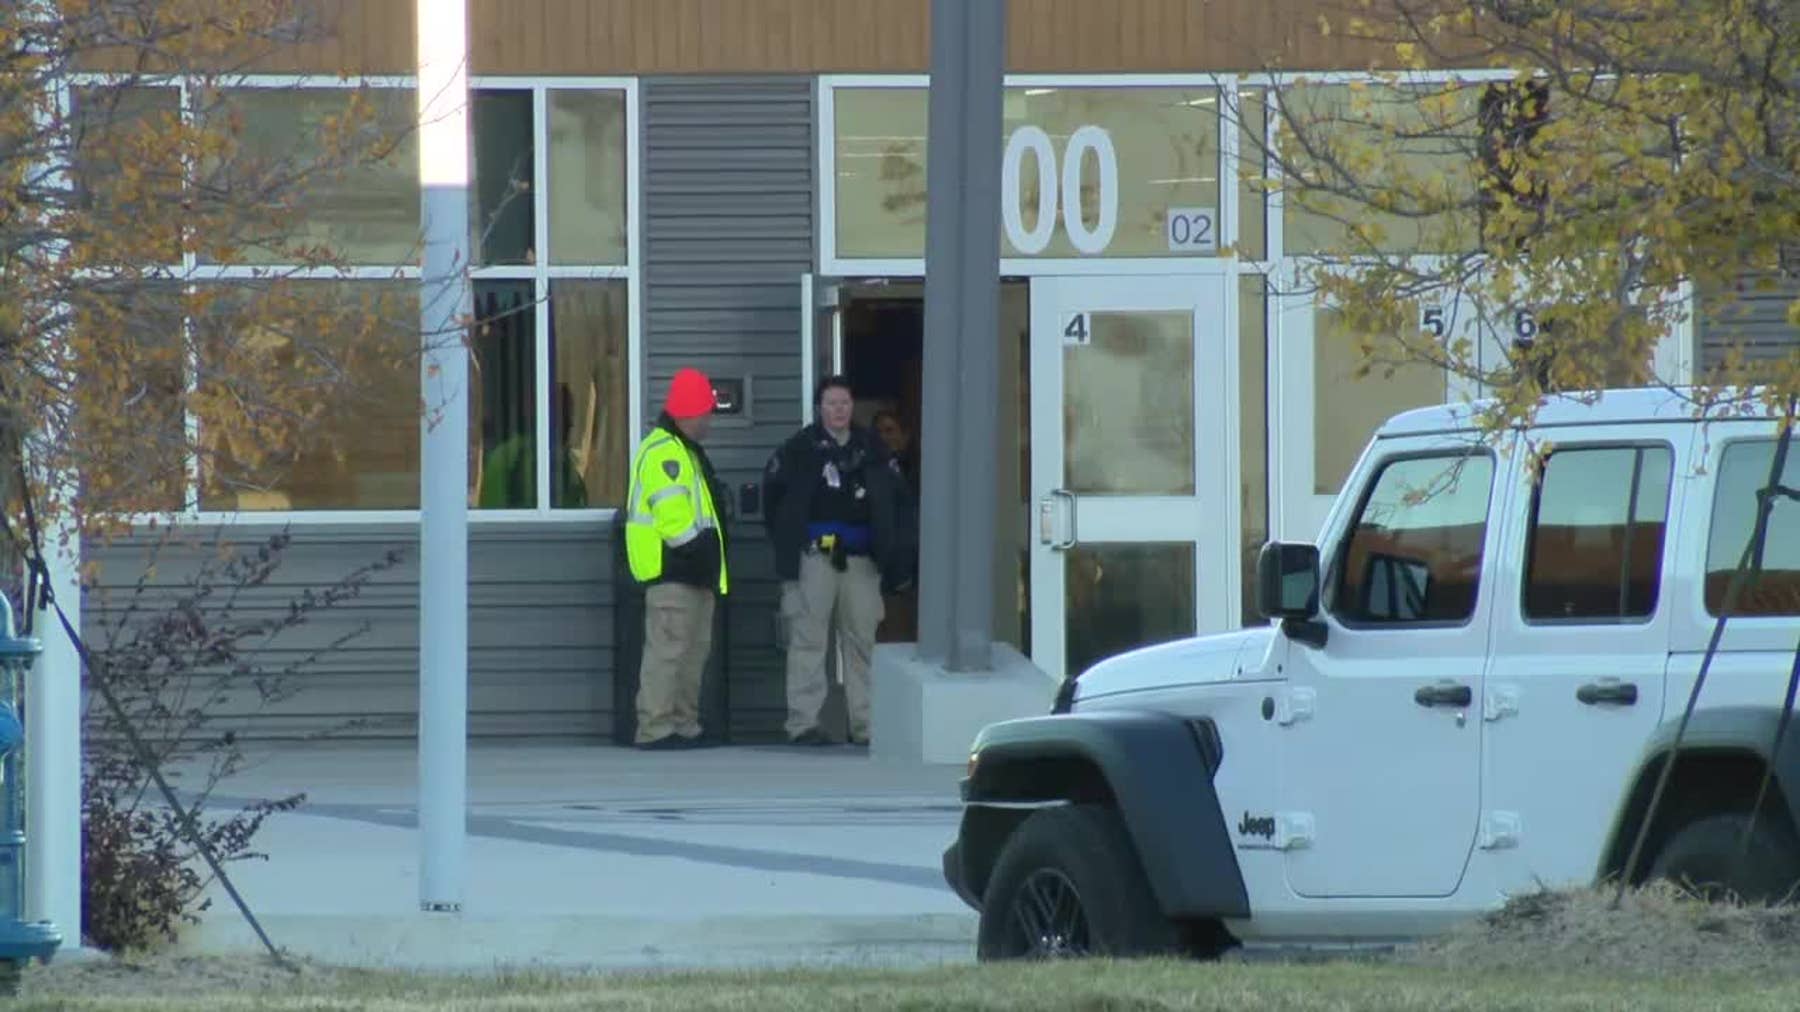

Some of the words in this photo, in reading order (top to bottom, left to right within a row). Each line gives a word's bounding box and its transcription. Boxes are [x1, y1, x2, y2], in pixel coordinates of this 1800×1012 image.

[1171, 214, 1212, 244] 02
[1064, 313, 1088, 342] 4
[1423, 309, 1444, 337] 5
[1515, 309, 1536, 338] 6
[1238, 810, 1275, 841] Jeep
